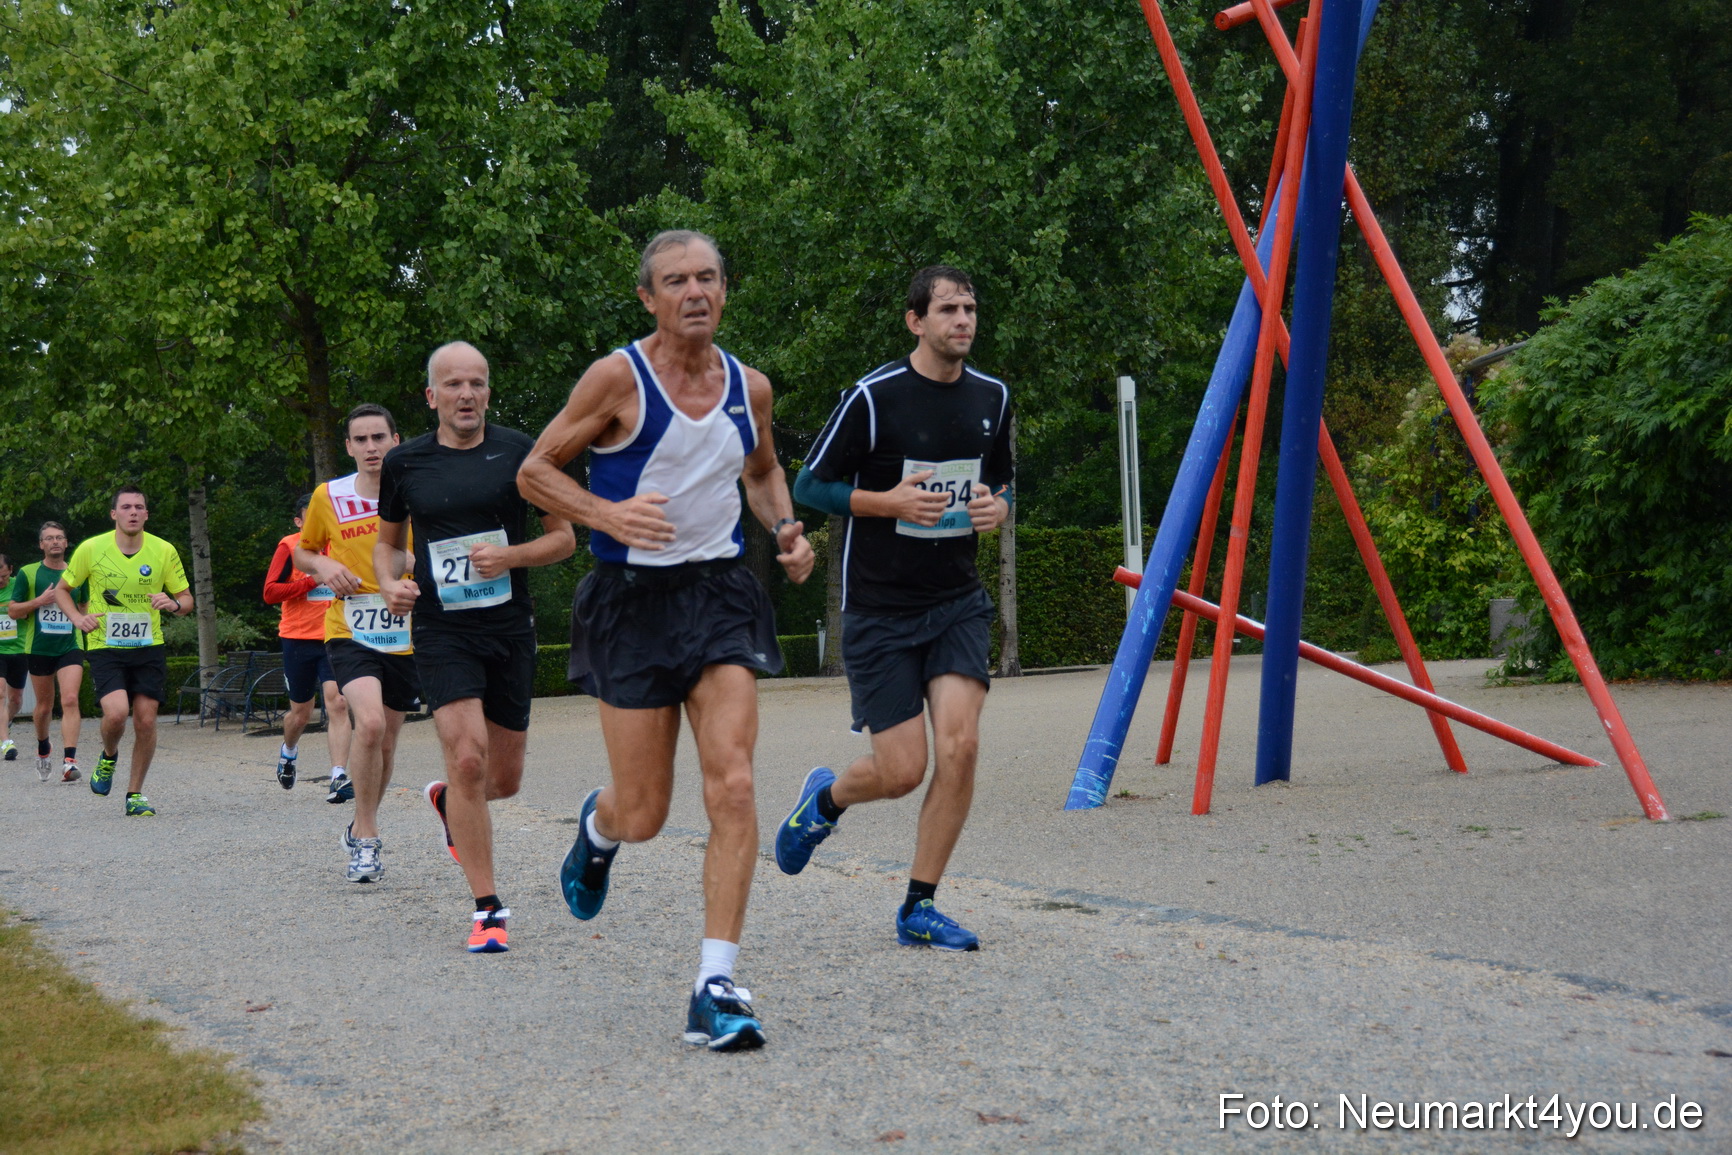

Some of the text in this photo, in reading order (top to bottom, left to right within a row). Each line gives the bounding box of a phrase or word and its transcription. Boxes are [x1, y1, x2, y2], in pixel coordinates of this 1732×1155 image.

[341, 522, 378, 540] MAX
[442, 555, 471, 583] 27
[464, 586, 495, 599] Marco
[352, 607, 405, 631] 2794
[111, 622, 149, 638] 2847
[363, 634, 398, 645] Matthias
